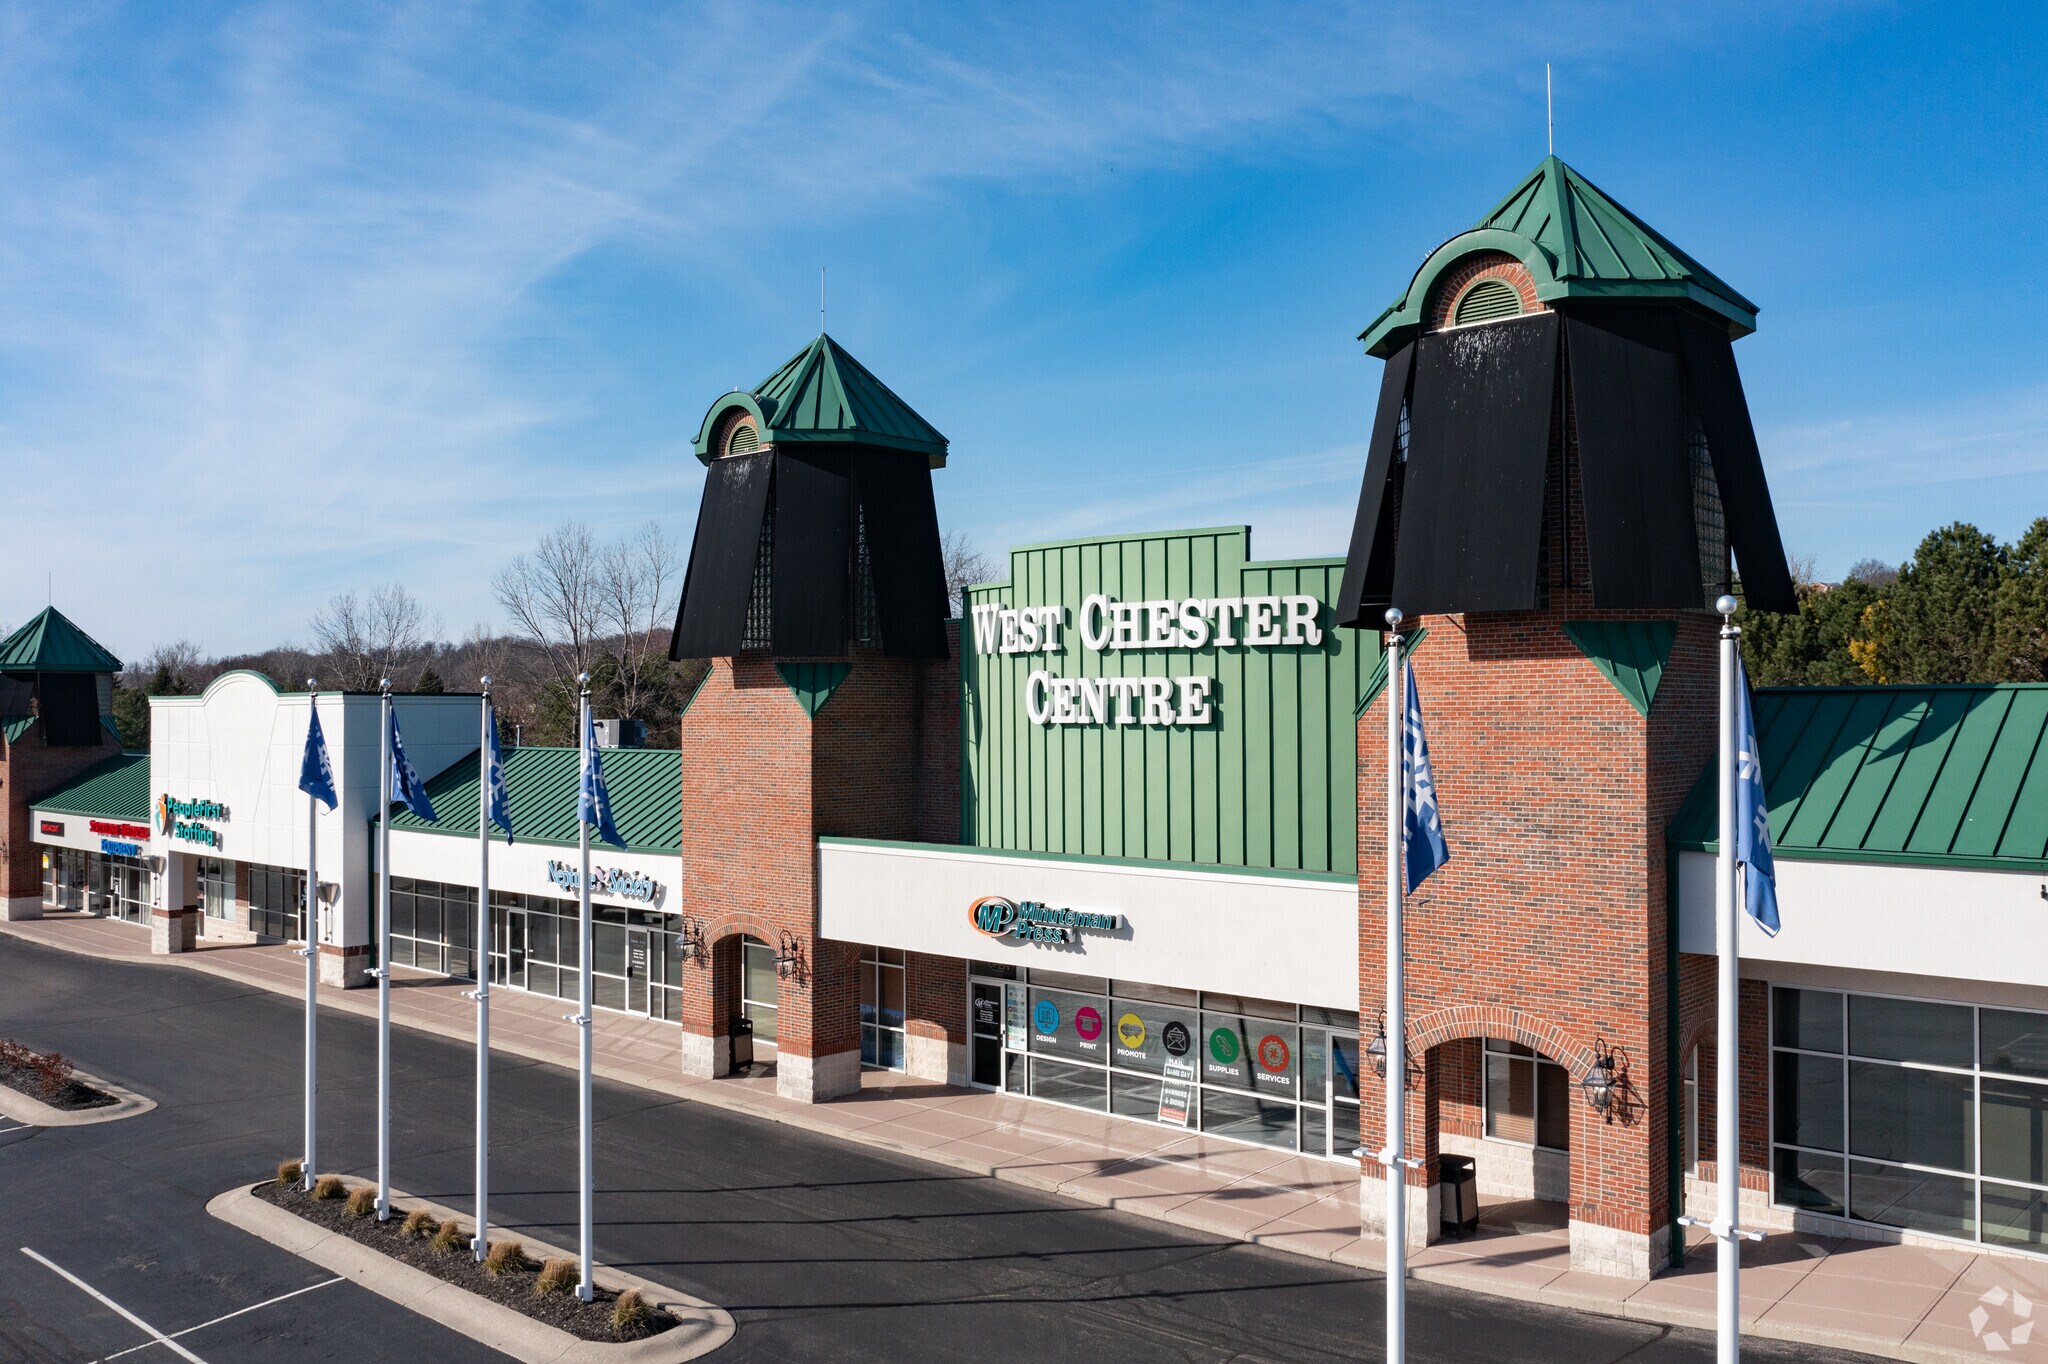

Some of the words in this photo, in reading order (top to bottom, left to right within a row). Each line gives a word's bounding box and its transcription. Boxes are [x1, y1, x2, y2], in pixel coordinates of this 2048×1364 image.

[174, 822, 214, 847] Staffing
[547, 860, 597, 892] Neptue
[609, 868, 655, 904] Society
[1018, 901, 1113, 930] Minuteman
[1036, 1034, 1057, 1044] DESIGN
[1079, 1041, 1097, 1050] PRINT
[1117, 1048, 1147, 1060] PROMOTE
[1208, 1064, 1240, 1076] SUPPLIES
[1257, 1072, 1290, 1085] SERVICES
